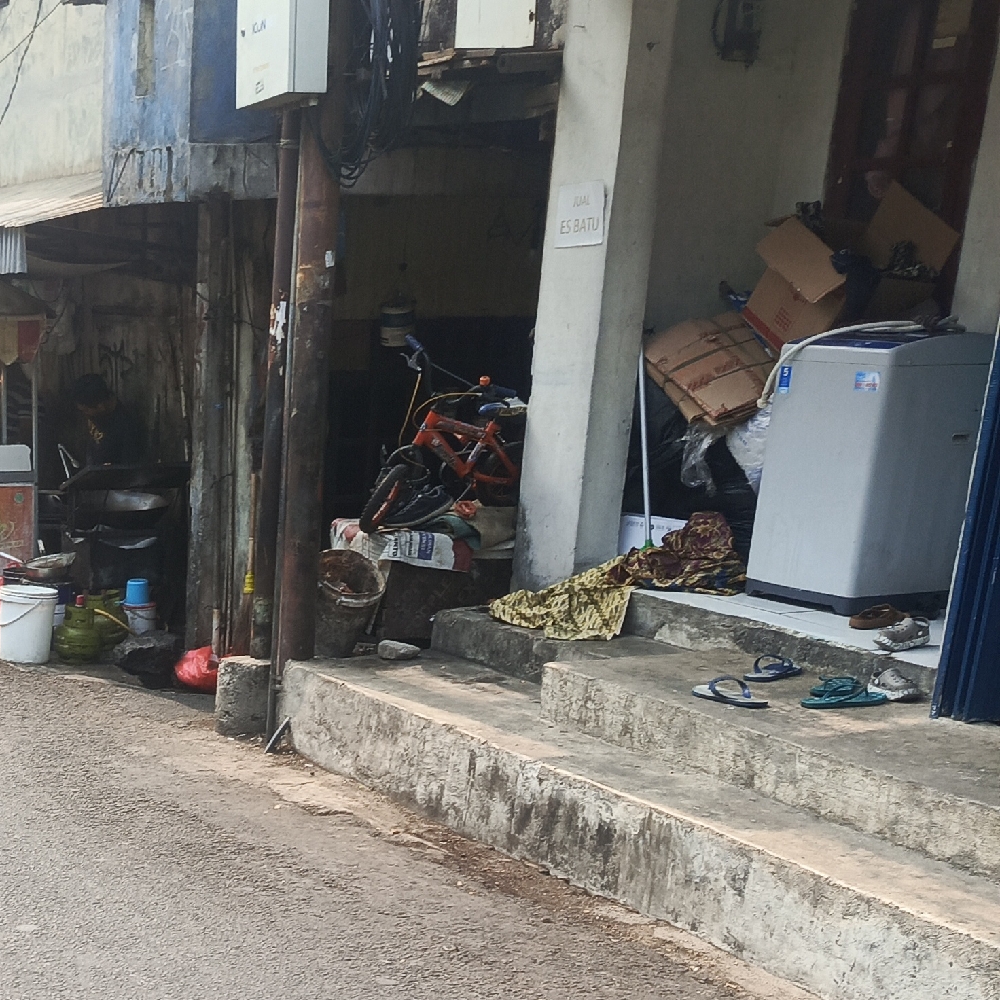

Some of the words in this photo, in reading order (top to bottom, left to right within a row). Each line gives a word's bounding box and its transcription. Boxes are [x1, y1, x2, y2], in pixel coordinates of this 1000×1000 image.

[572, 194, 591, 208] JUAL
[559, 219, 572, 235] ES
[573, 216, 600, 233] BATU
